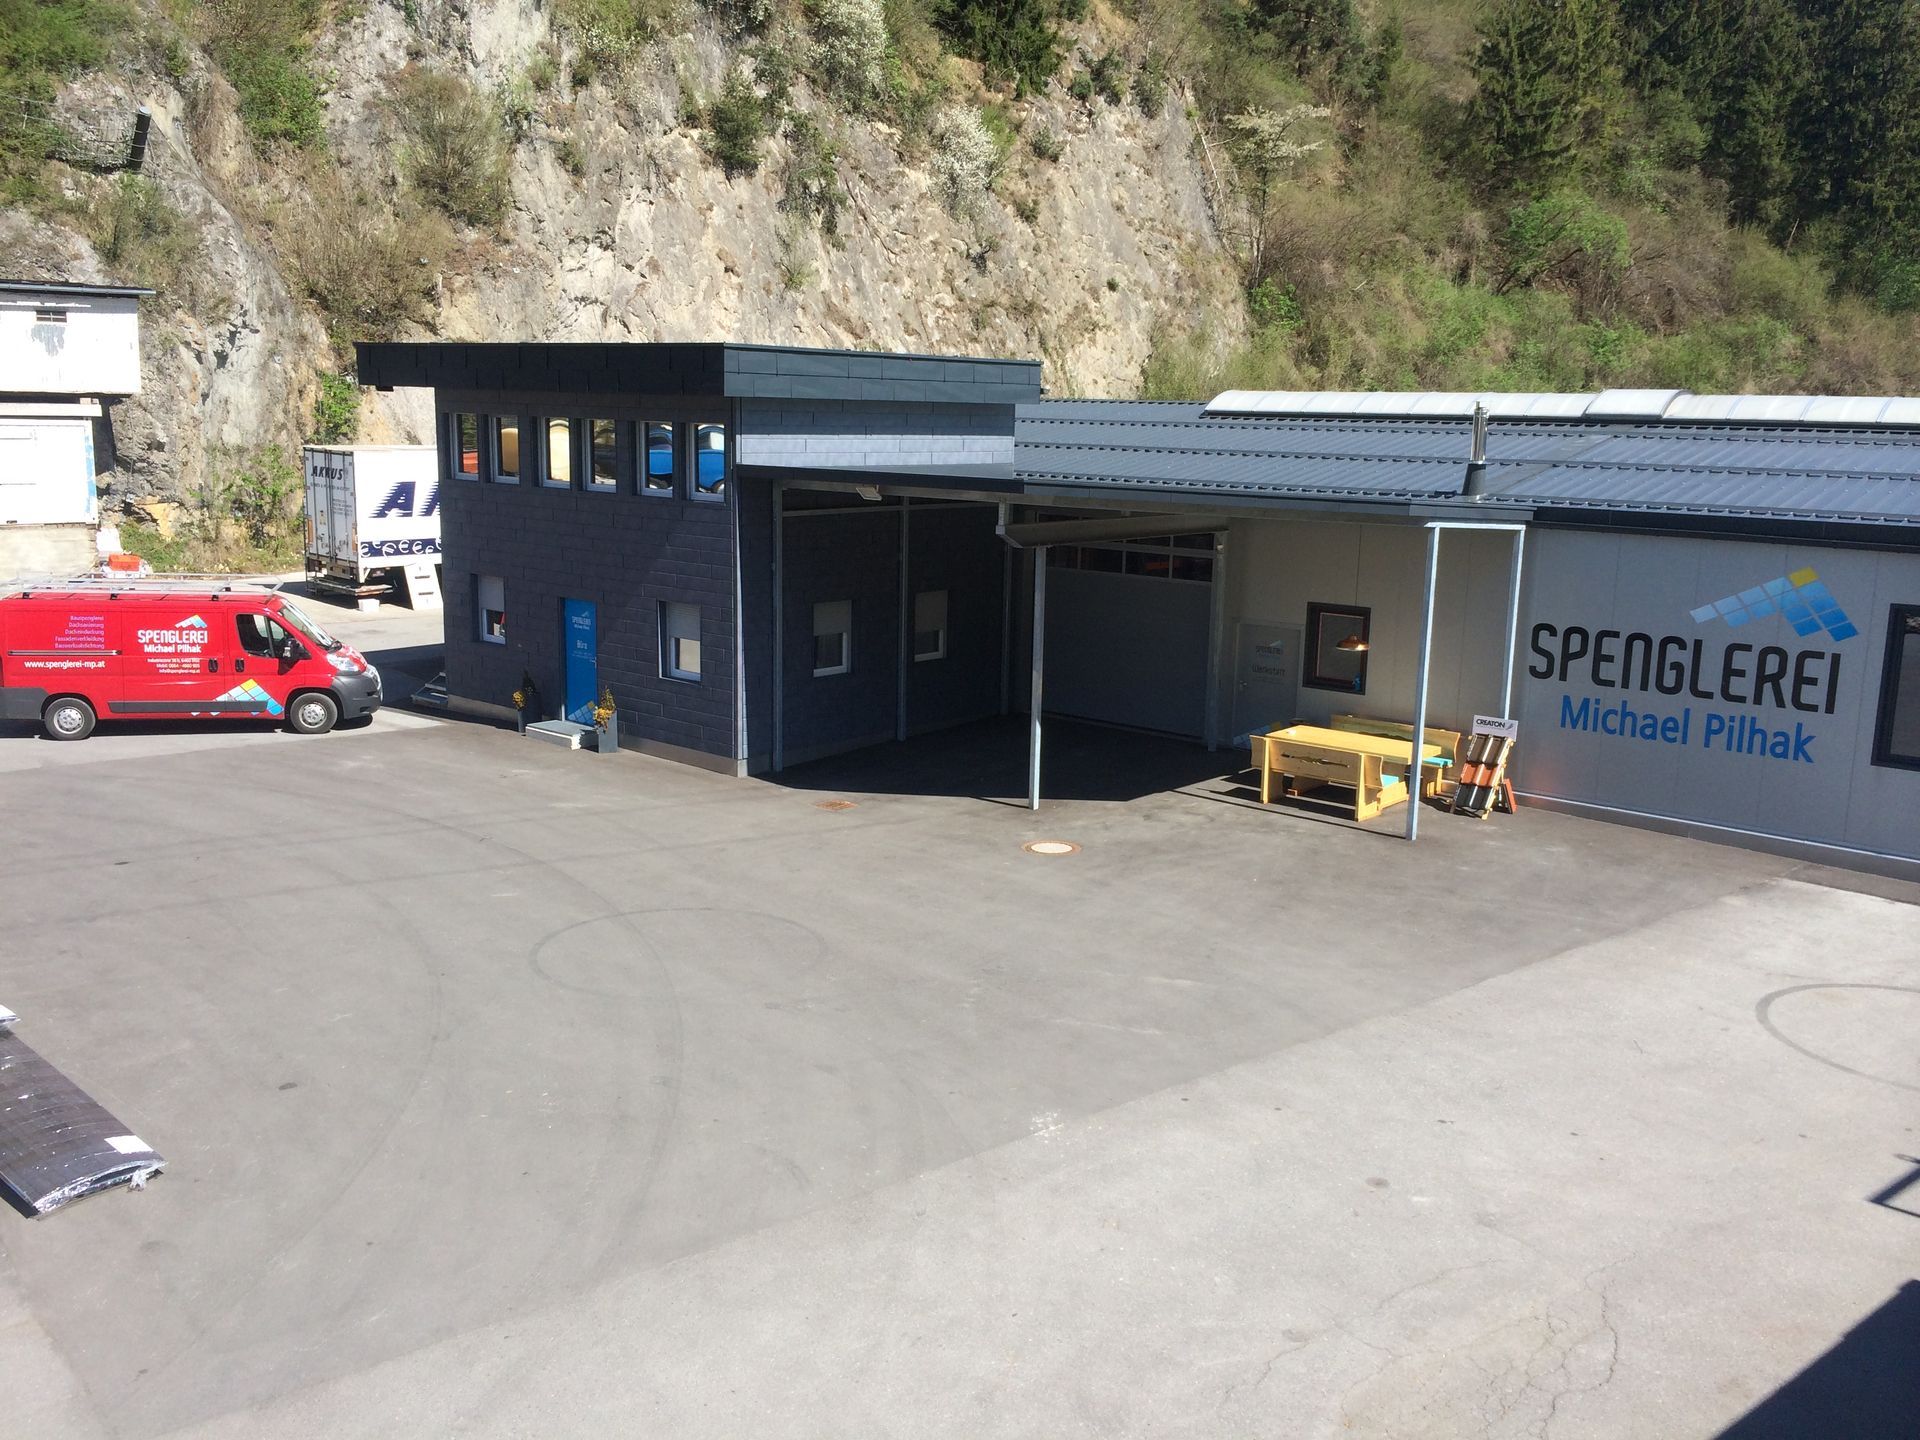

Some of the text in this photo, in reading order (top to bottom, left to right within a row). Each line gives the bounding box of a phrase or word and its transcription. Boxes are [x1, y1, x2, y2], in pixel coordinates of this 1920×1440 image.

[137, 629, 208, 644] SPENGLEREI
[144, 644, 202, 653] Michael Pilhak
[24, 660, 106, 670] www.spenglerei-mp.at
[1529, 623, 1841, 715] SPENGLEREI
[1475, 718, 1506, 729] CREATON
[1560, 695, 1817, 763] Michael Pilhak
